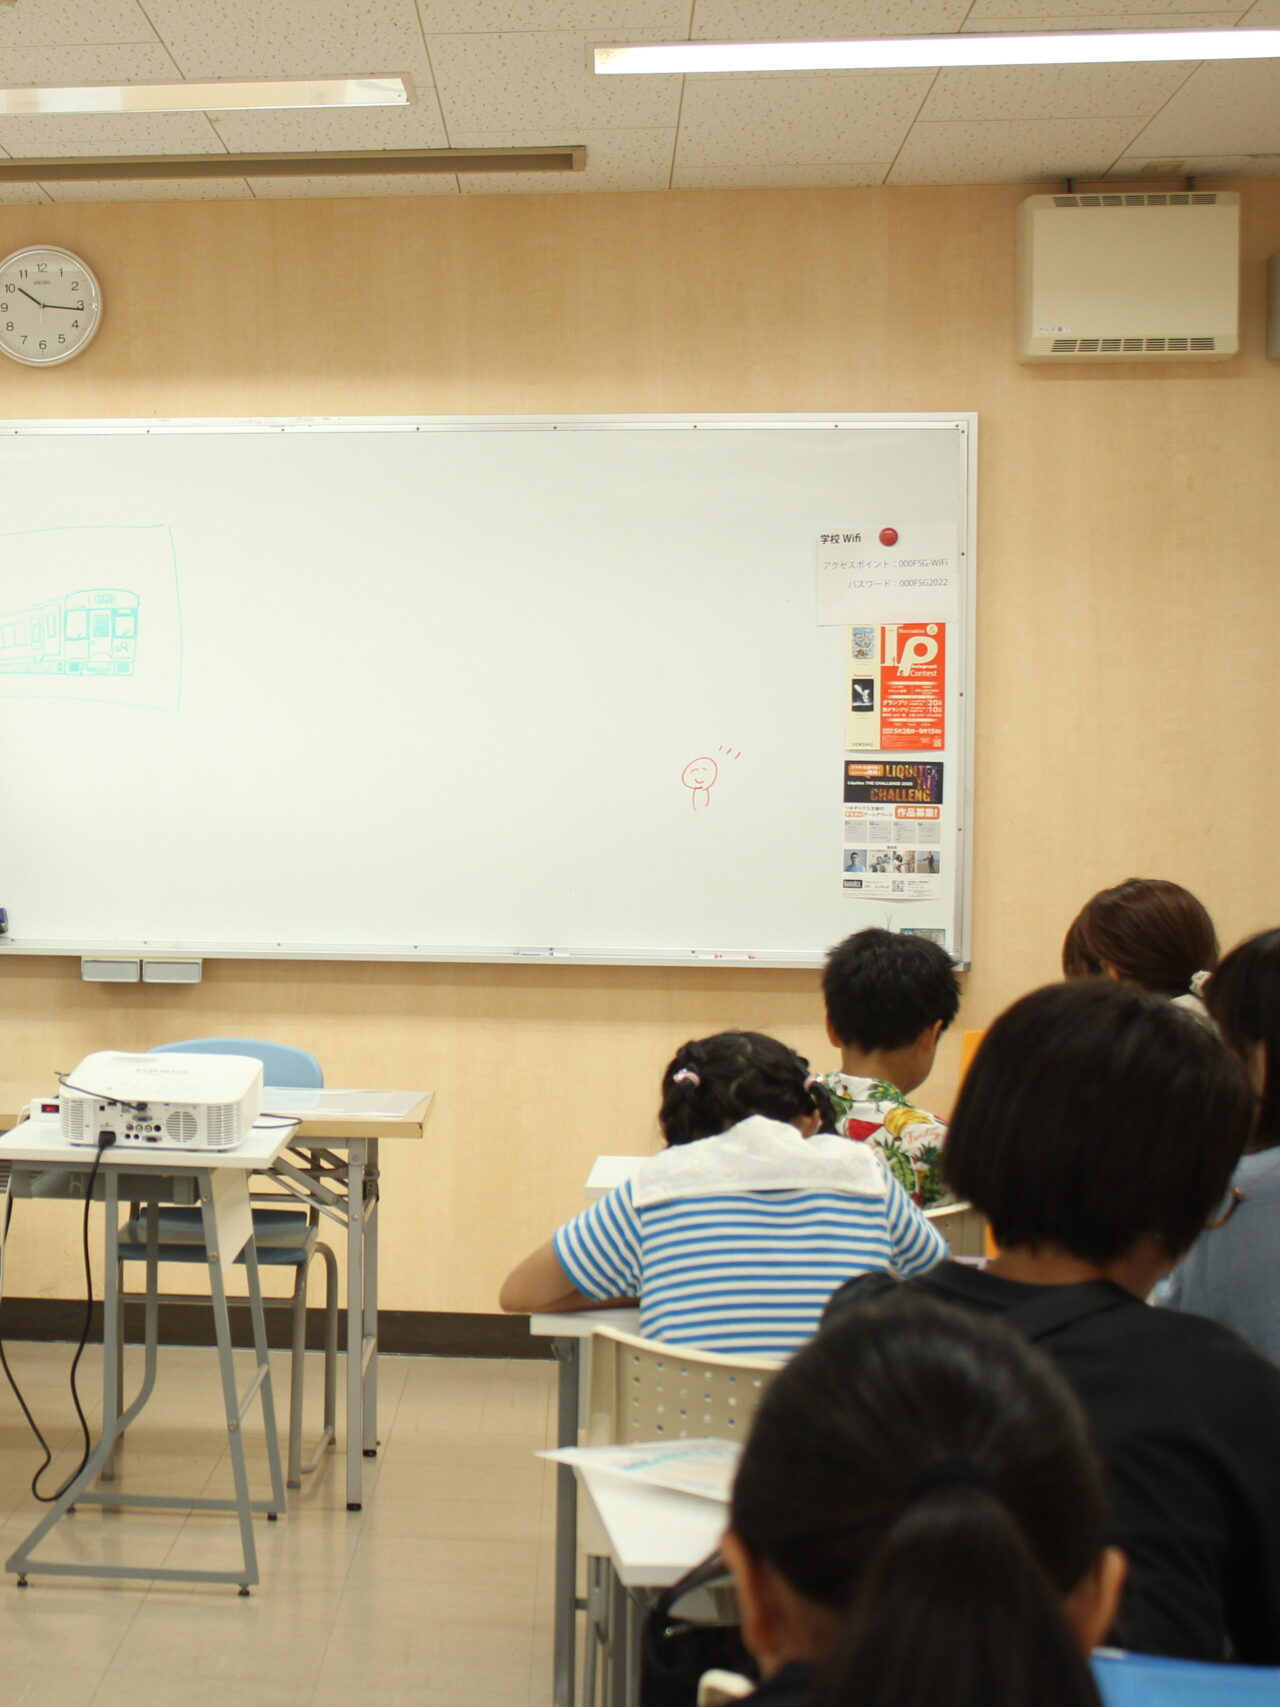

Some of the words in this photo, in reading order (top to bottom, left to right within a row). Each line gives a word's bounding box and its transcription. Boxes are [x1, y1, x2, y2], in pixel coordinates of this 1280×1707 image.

[36, 263, 47, 273] 12
[19, 269, 28, 279] 11
[5, 283, 16, 293] 10
[71, 281, 79, 291] 2
[0, 302, 9, 312] 9
[76, 300, 85, 310] 3
[6, 321, 14, 331] 8
[71, 320, 79, 329] 4
[20, 335, 28, 345] 7
[58, 333, 66, 344] 5
[39, 340, 47, 350] 6
[820, 533, 840, 544] 学校
[842, 533, 862, 543] Wifi
